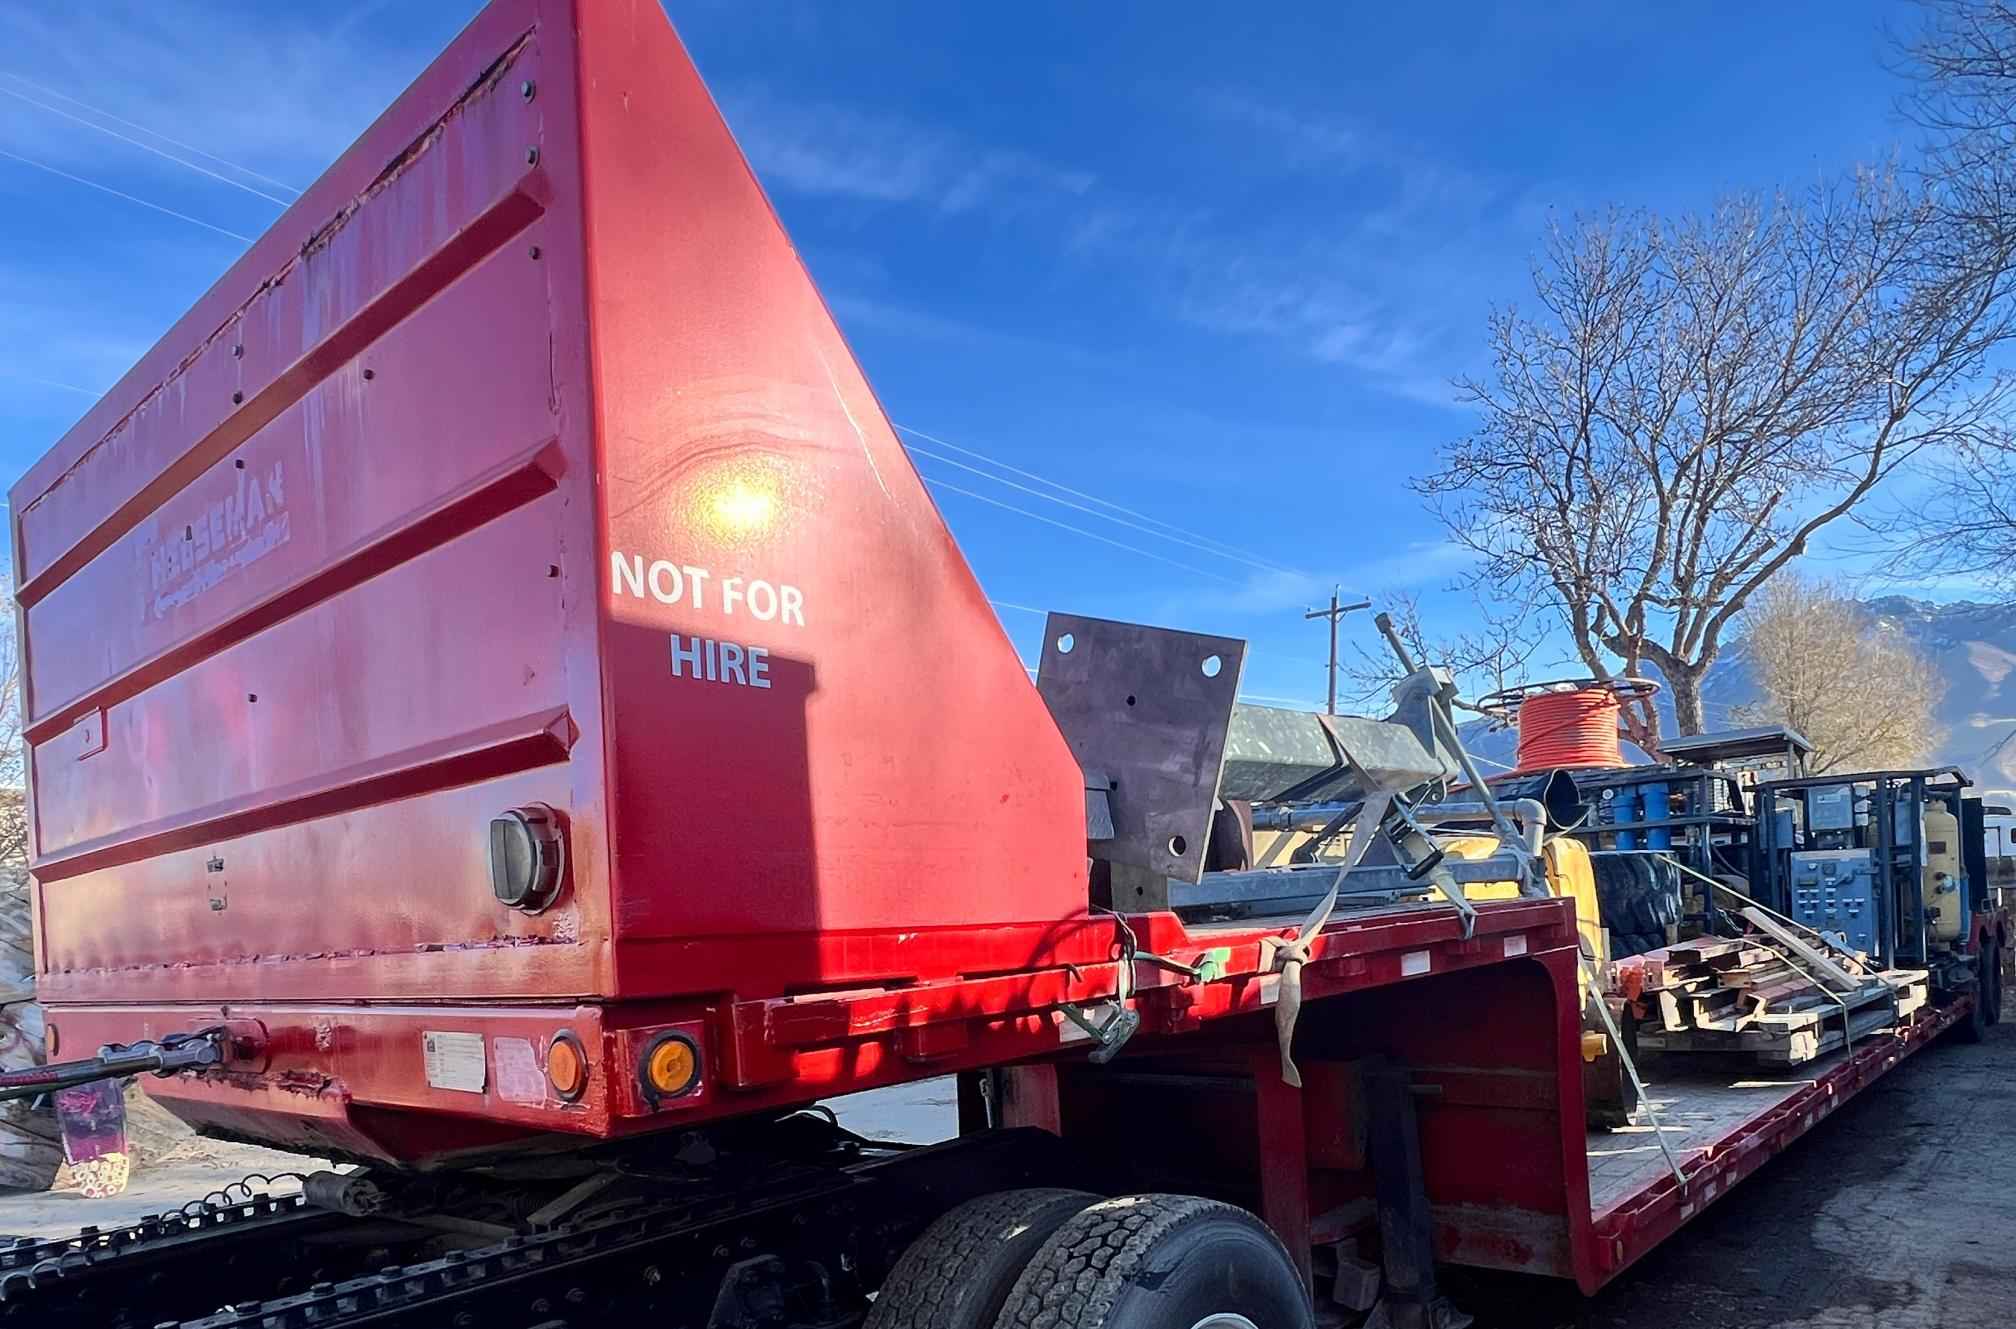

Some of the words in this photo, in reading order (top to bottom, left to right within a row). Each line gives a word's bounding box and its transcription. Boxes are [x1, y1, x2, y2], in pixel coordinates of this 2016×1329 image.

[611, 551, 710, 609] NOT
[721, 577, 806, 627] FOR
[670, 634, 772, 688] HIRE
